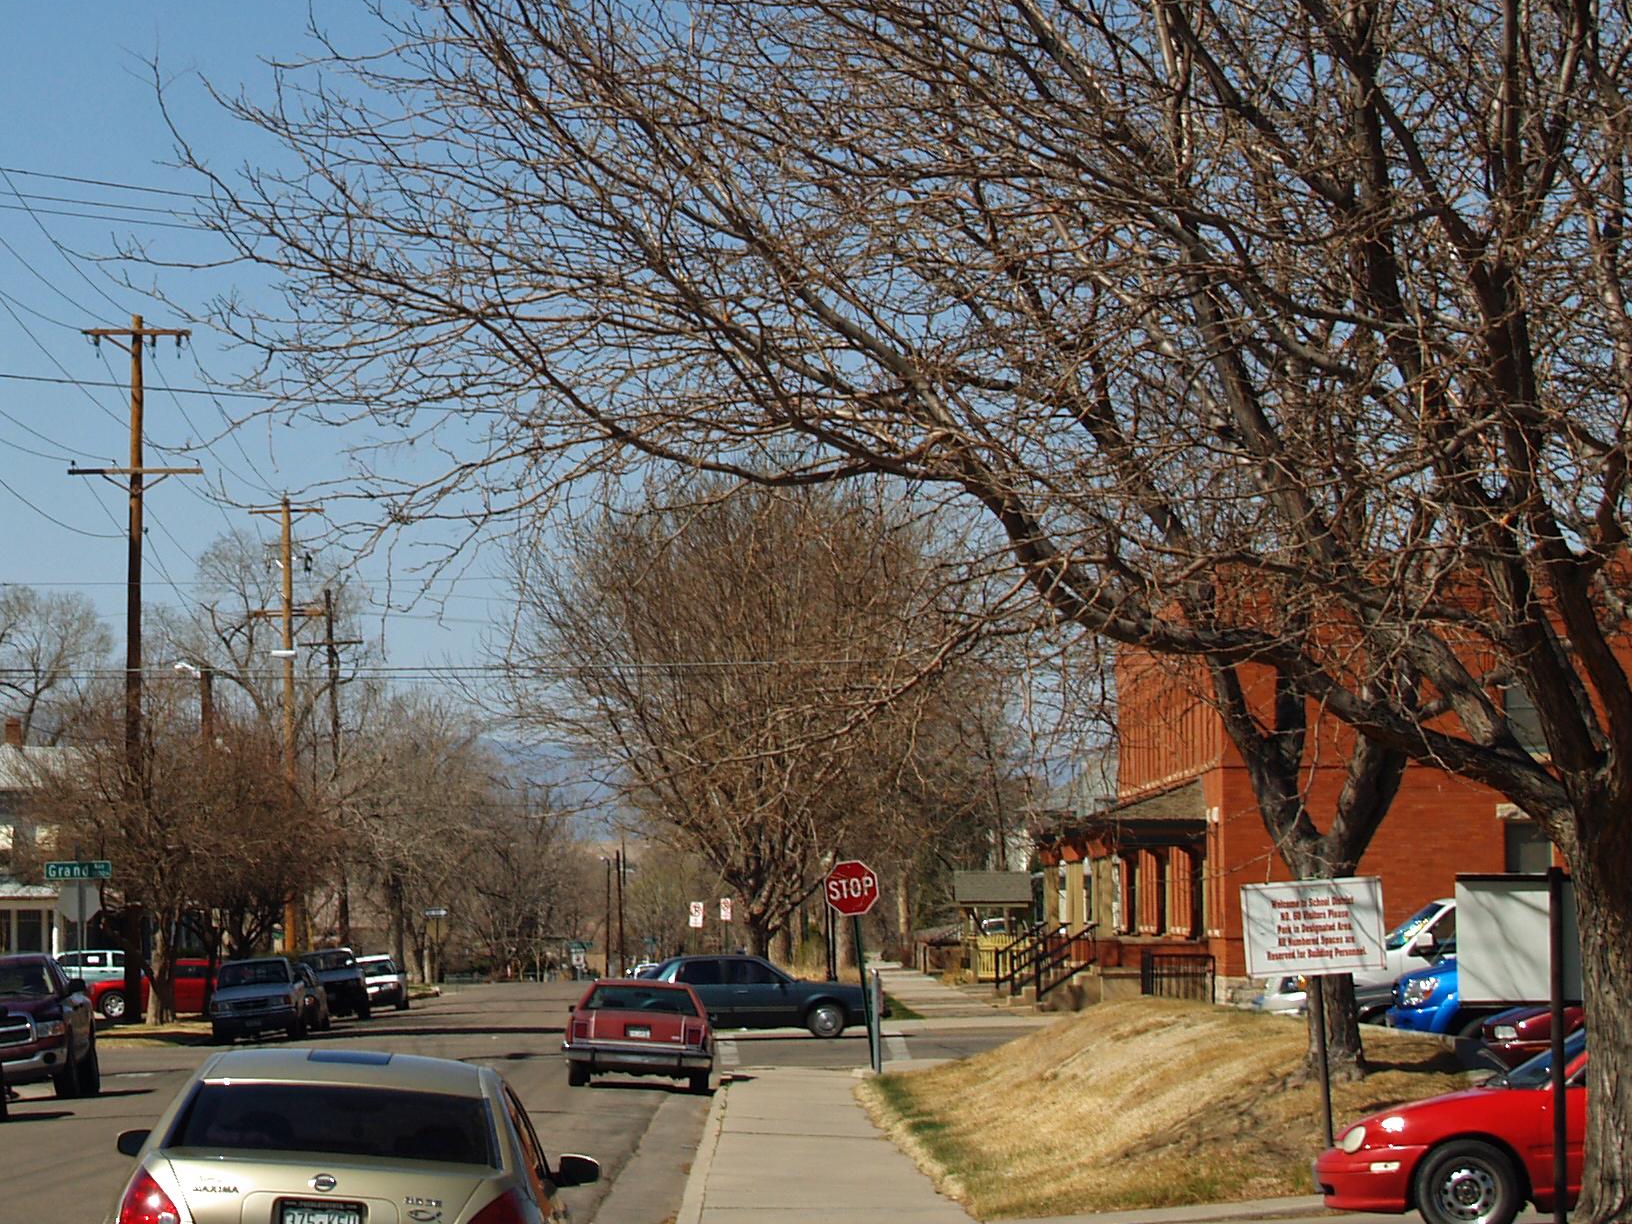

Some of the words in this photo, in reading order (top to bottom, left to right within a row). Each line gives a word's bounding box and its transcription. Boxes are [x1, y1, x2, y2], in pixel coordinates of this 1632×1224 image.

[49, 864, 89, 877] Grand
[828, 876, 873, 901] STOP
[1271, 899, 1299, 909] Welcome
[1301, 899, 1307, 907] to
[1309, 897, 1329, 907] School
[1302, 910, 1326, 920] Visitors
[1328, 909, 1350, 918] Please
[1277, 925, 1292, 934] Park
[1293, 925, 1300, 933] in
[1302, 923, 1335, 934] Designated
[1288, 937, 1319, 946] Numbered
[1320, 936, 1343, 946] Spaces
[1267, 950, 1295, 960] Reserved
[1297, 949, 1306, 958] for
[1308, 947, 1333, 959] Building
